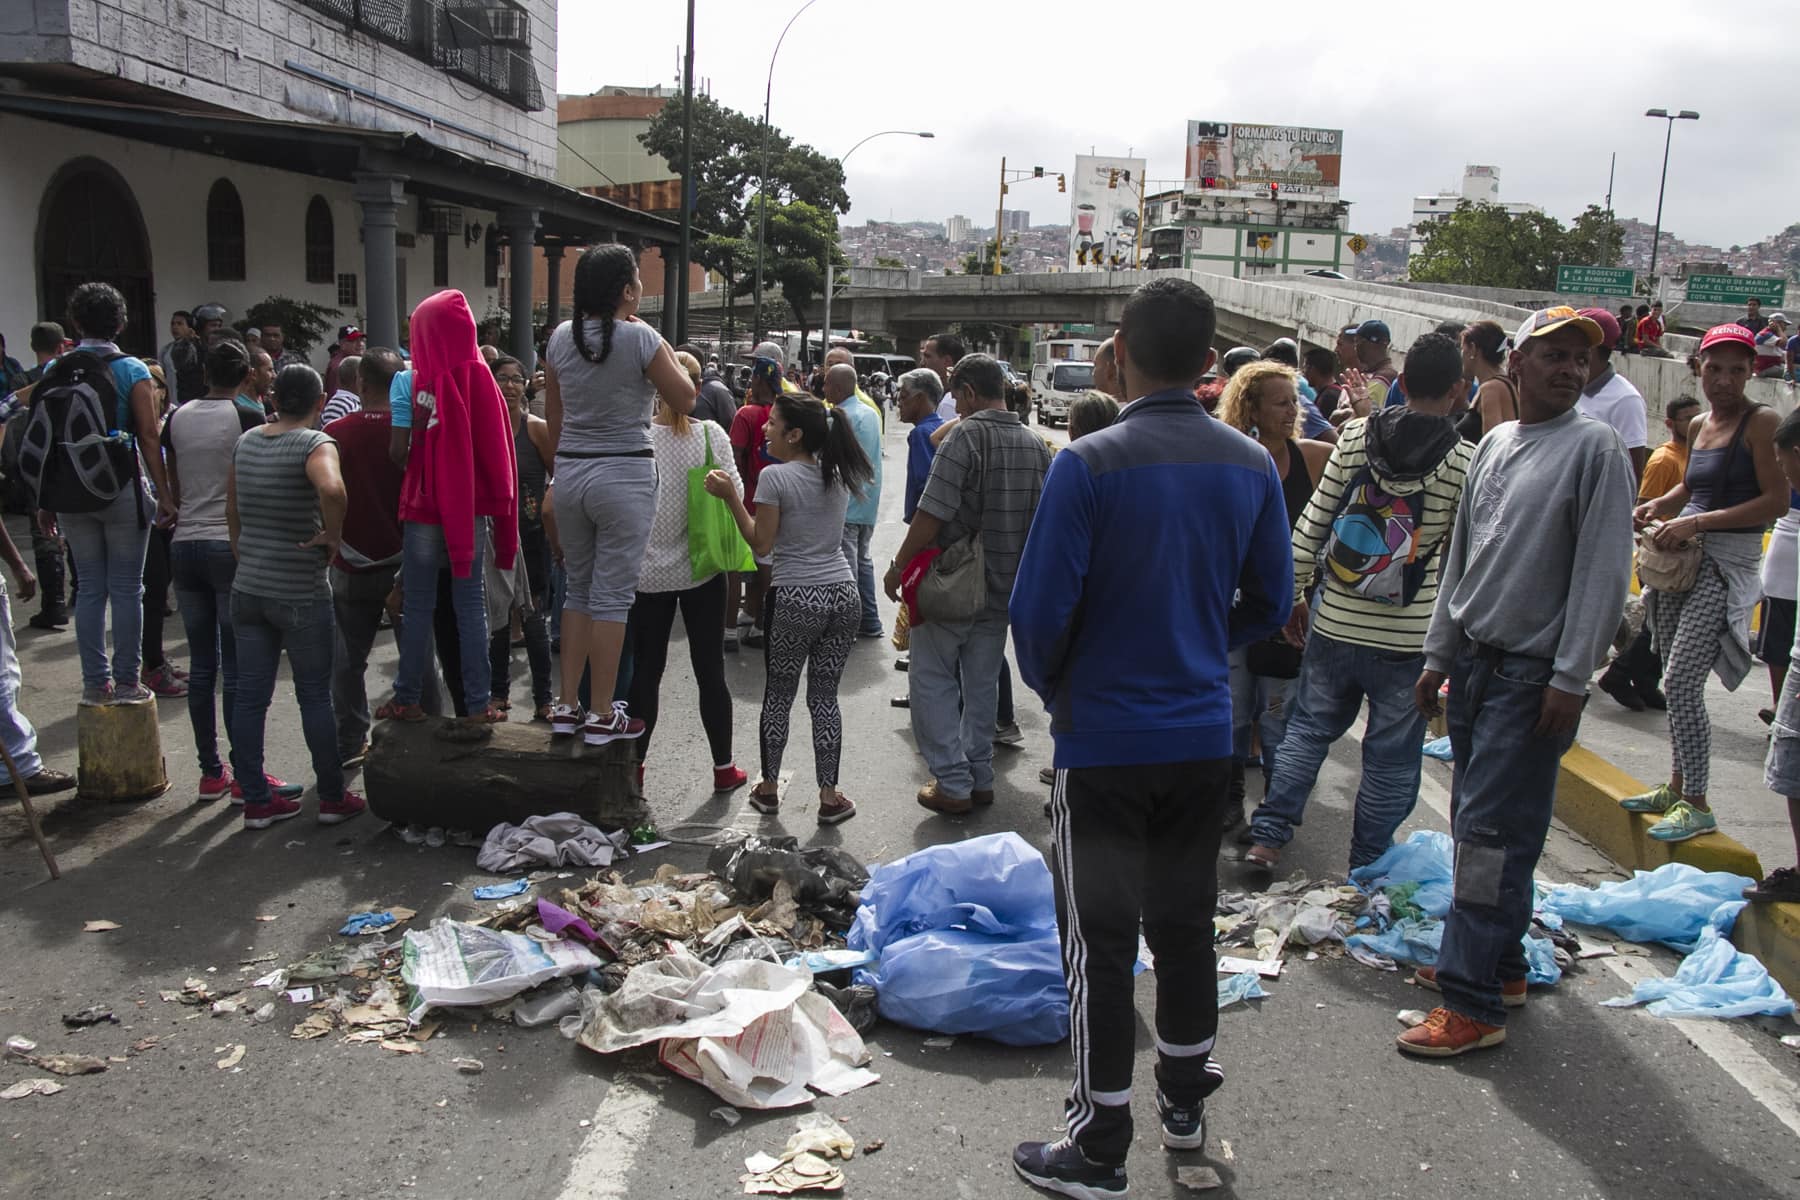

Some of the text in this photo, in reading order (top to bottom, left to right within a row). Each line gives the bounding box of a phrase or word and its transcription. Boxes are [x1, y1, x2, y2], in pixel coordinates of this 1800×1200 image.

[1234, 126, 1335, 143] FORMAMOS TU FUTURO
